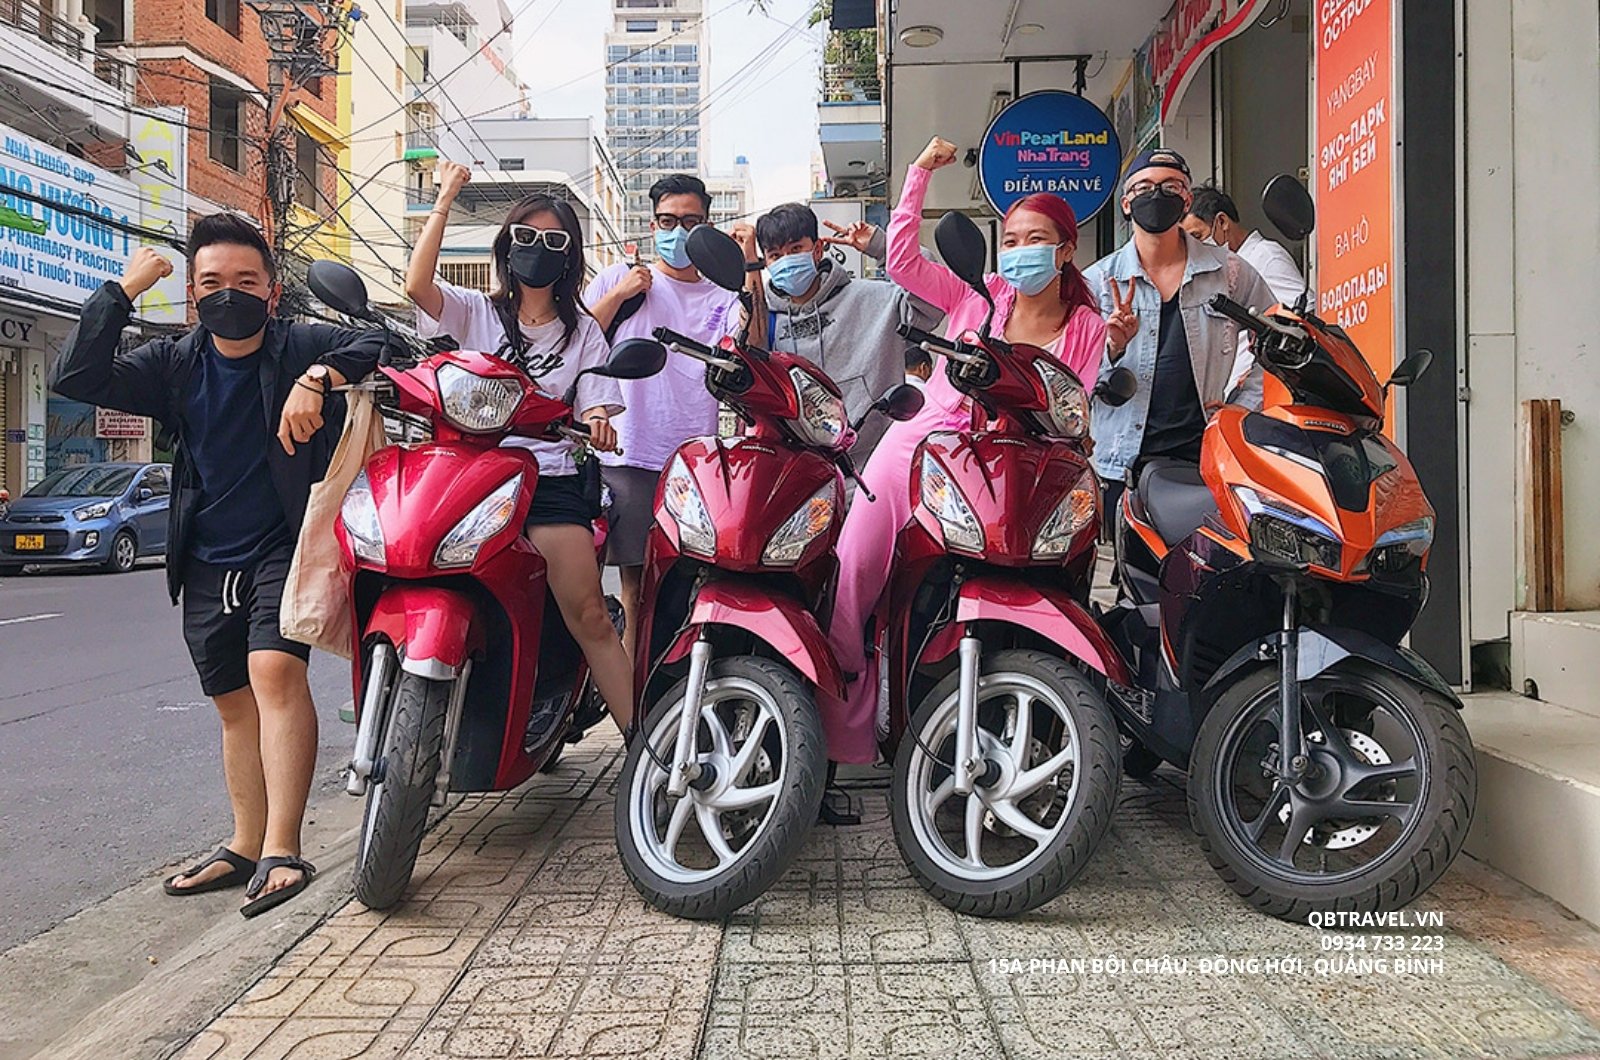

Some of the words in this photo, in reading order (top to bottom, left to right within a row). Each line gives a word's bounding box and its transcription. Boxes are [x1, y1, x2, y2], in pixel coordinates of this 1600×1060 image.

[1326, 51, 1379, 117] YANGBAY
[5, 136, 31, 163] NHÀ
[1320, 97, 1386, 169] ЭКО-ПАРК
[1327, 157, 1350, 191] ЯНГ
[1352, 130, 1377, 176] БЕЙ
[1004, 174, 1044, 193] ĐIỂM
[1048, 175, 1080, 192] BÁN
[8, 227, 72, 262] PHARMACY
[75, 247, 124, 277] PRACTICE
[1335, 231, 1350, 258] BA
[37, 261, 71, 285] THUỐC
[1321, 262, 1388, 314] ВОДОПАДЫ
[1337, 300, 1368, 330] БАХО
